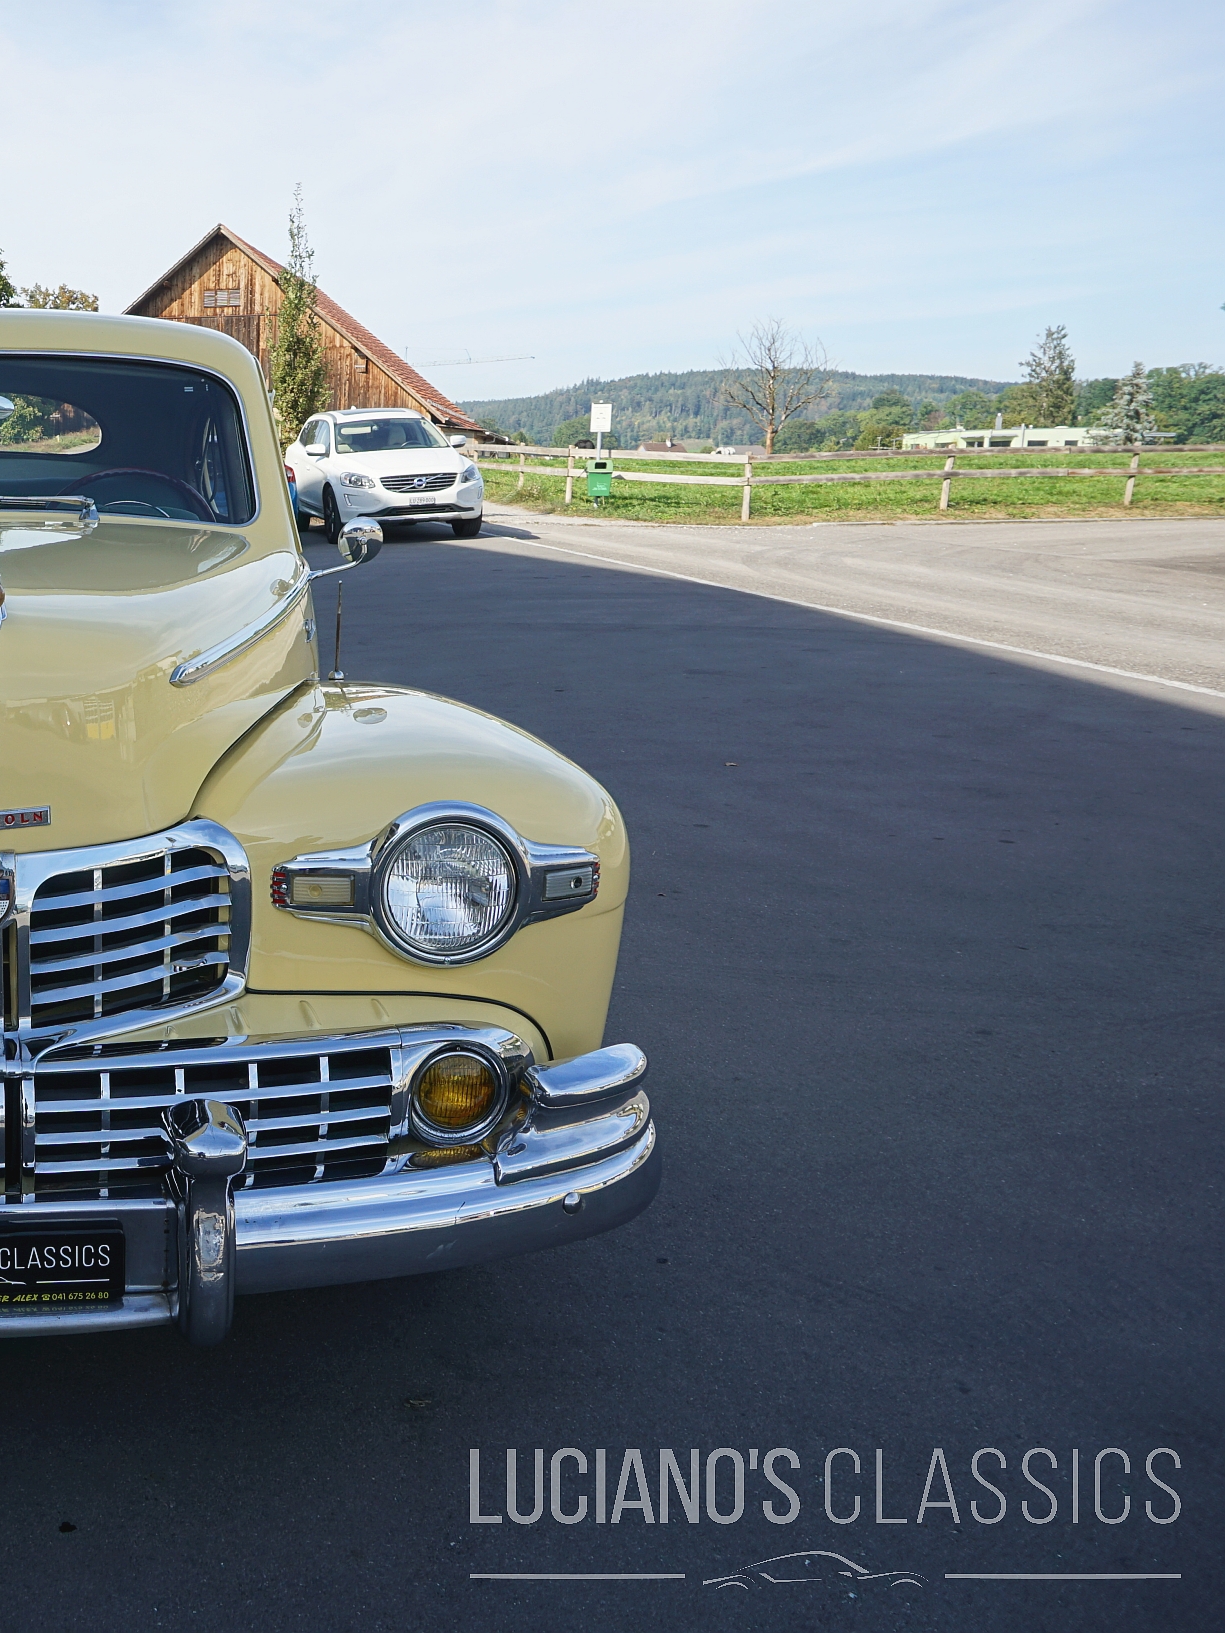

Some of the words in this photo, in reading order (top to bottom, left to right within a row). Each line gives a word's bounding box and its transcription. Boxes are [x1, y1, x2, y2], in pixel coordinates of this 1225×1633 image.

[12, 1294, 39, 1302] ALEX
[51, 1292, 66, 1301] 041
[68, 1292, 84, 1301] 675
[85, 1292, 96, 1300] 26
[97, 1291, 110, 1299] 80
